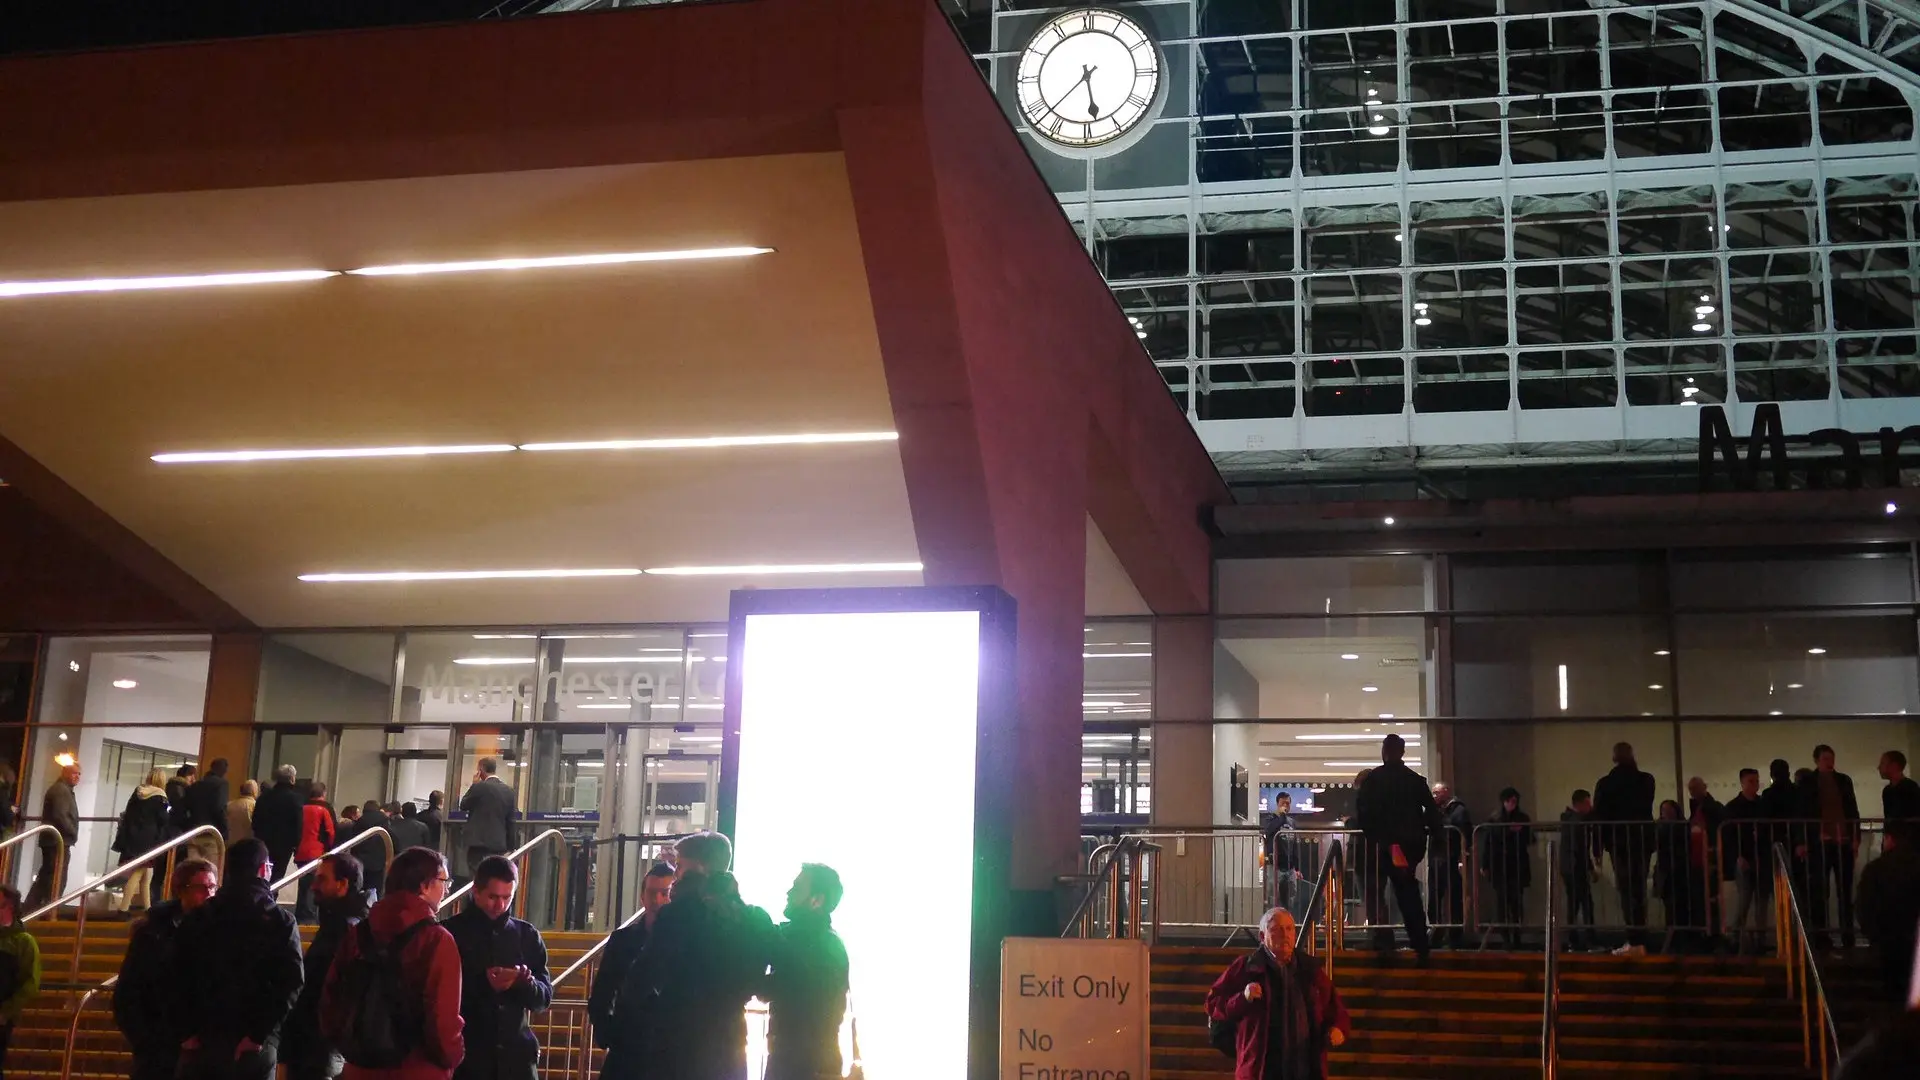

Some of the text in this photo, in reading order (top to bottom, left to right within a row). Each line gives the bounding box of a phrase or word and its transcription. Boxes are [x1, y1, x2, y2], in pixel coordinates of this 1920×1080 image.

[419, 658, 675, 704] Manchester
[1019, 974, 1130, 1005] Exit Only
[1018, 1028, 1053, 1052] No
[1018, 1062, 1131, 1080] Entrance
